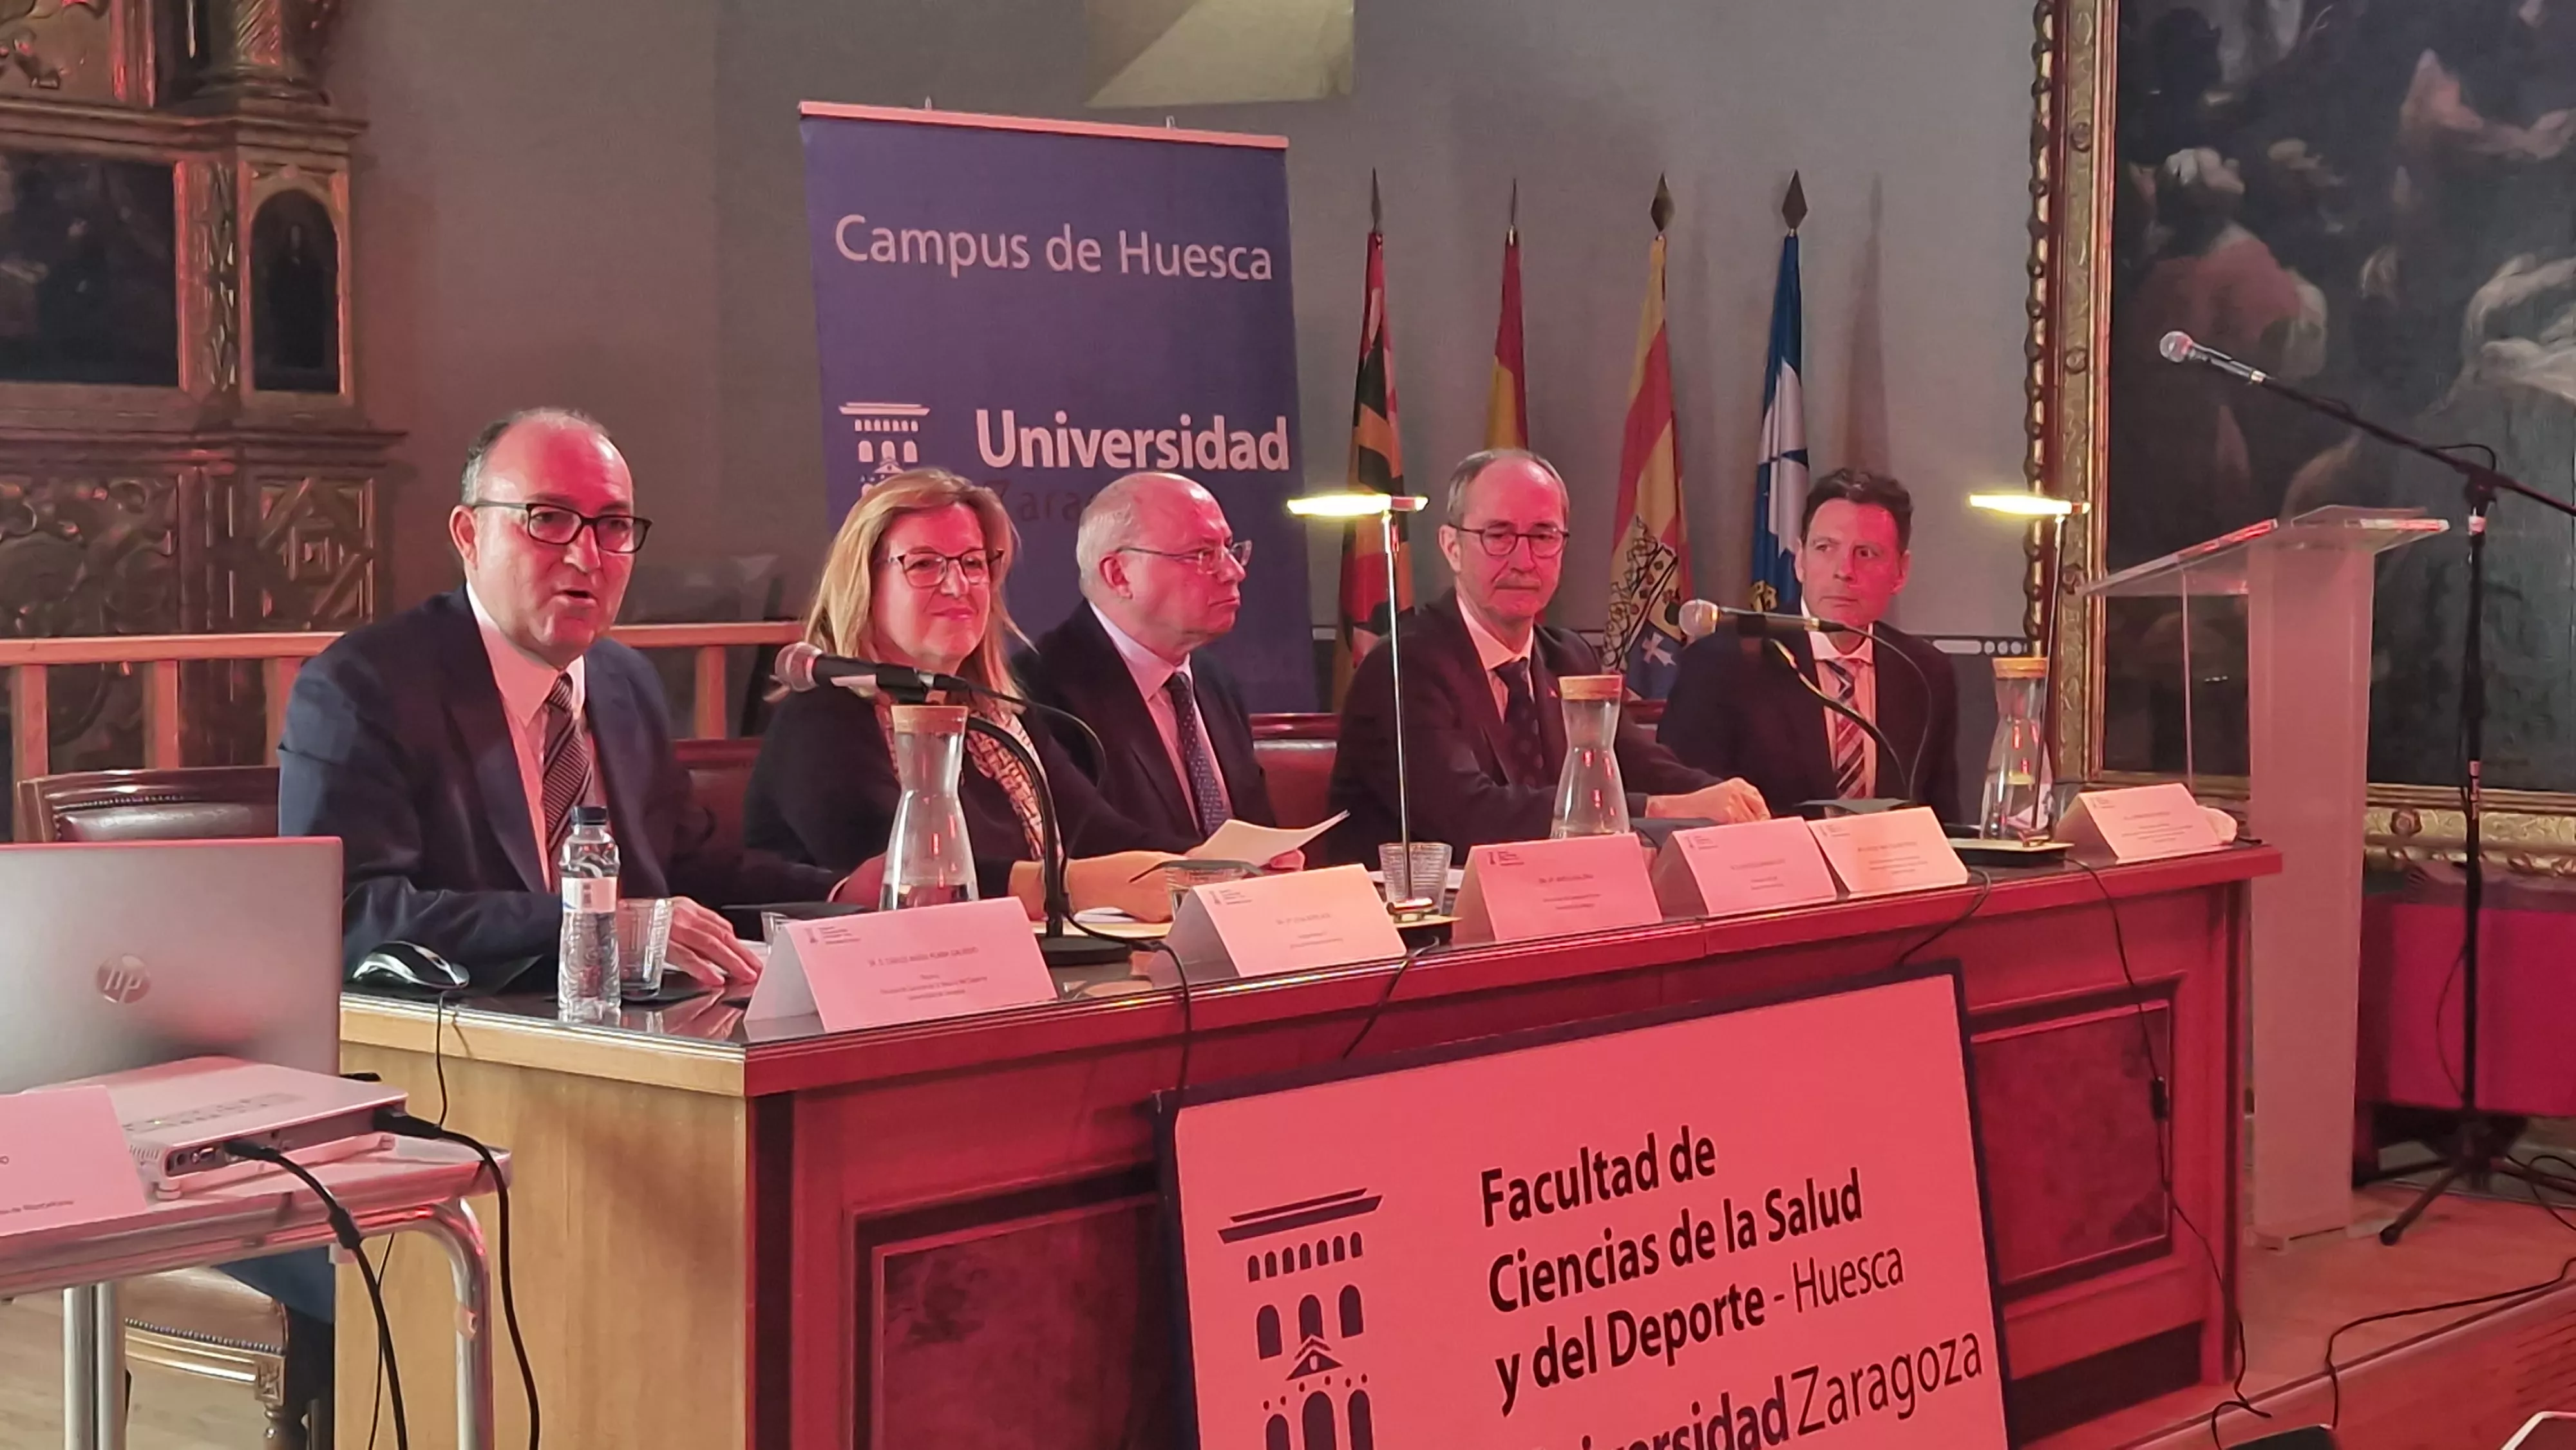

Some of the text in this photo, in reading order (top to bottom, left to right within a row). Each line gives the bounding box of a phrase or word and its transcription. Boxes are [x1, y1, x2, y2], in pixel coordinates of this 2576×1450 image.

[835, 214, 1273, 281] Campus de Huesca
[976, 409, 1290, 471] Universidad
[102, 959, 146, 1004] hp
[1481, 1125, 1716, 1228] Facultad de
[1489, 1167, 1863, 1312] Ciencias de la Salud
[1495, 1353, 1520, 1417] y
[1532, 1315, 1597, 1388] del
[1607, 1283, 1765, 1367] Deporte
[1792, 1247, 1904, 1313] Huesca
